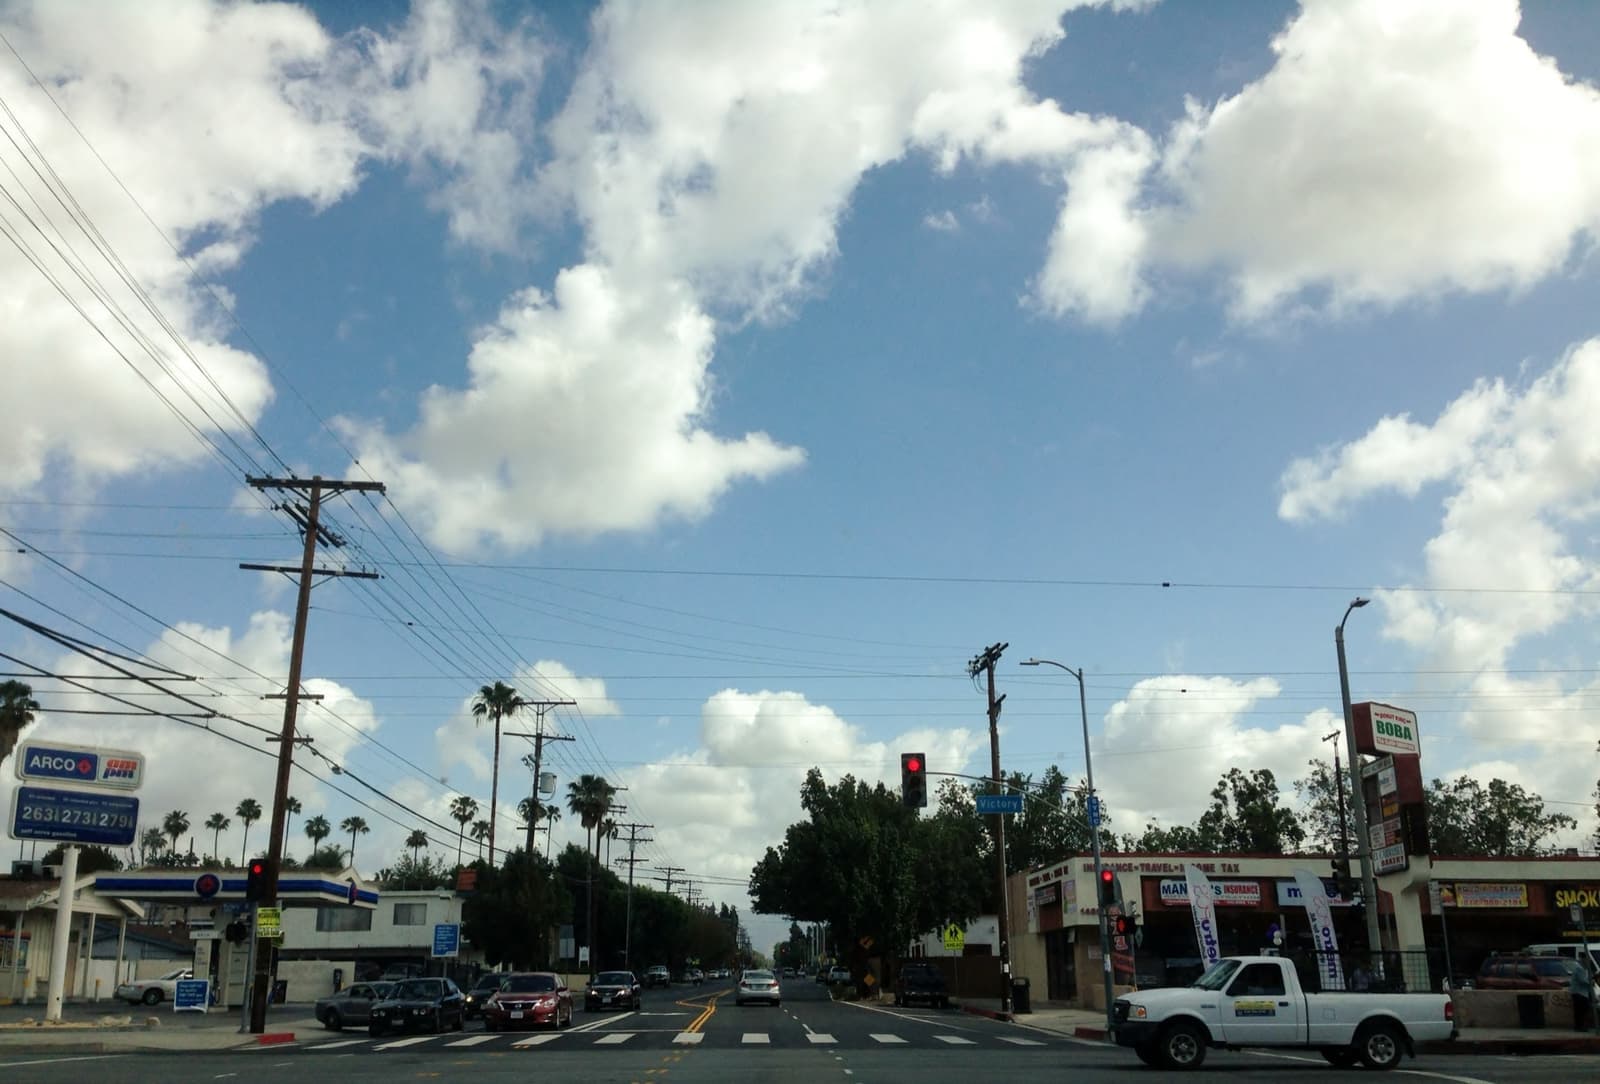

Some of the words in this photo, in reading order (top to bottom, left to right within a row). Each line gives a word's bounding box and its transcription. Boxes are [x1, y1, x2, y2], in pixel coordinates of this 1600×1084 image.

[1376, 719, 1413, 741] BOBA
[30, 755, 76, 771] ARCO
[980, 799, 1018, 809] Victory
[1140, 863, 1174, 872] TRAVEL
[1221, 863, 1240, 872] TAX
[1555, 889, 1600, 907] SMOK
